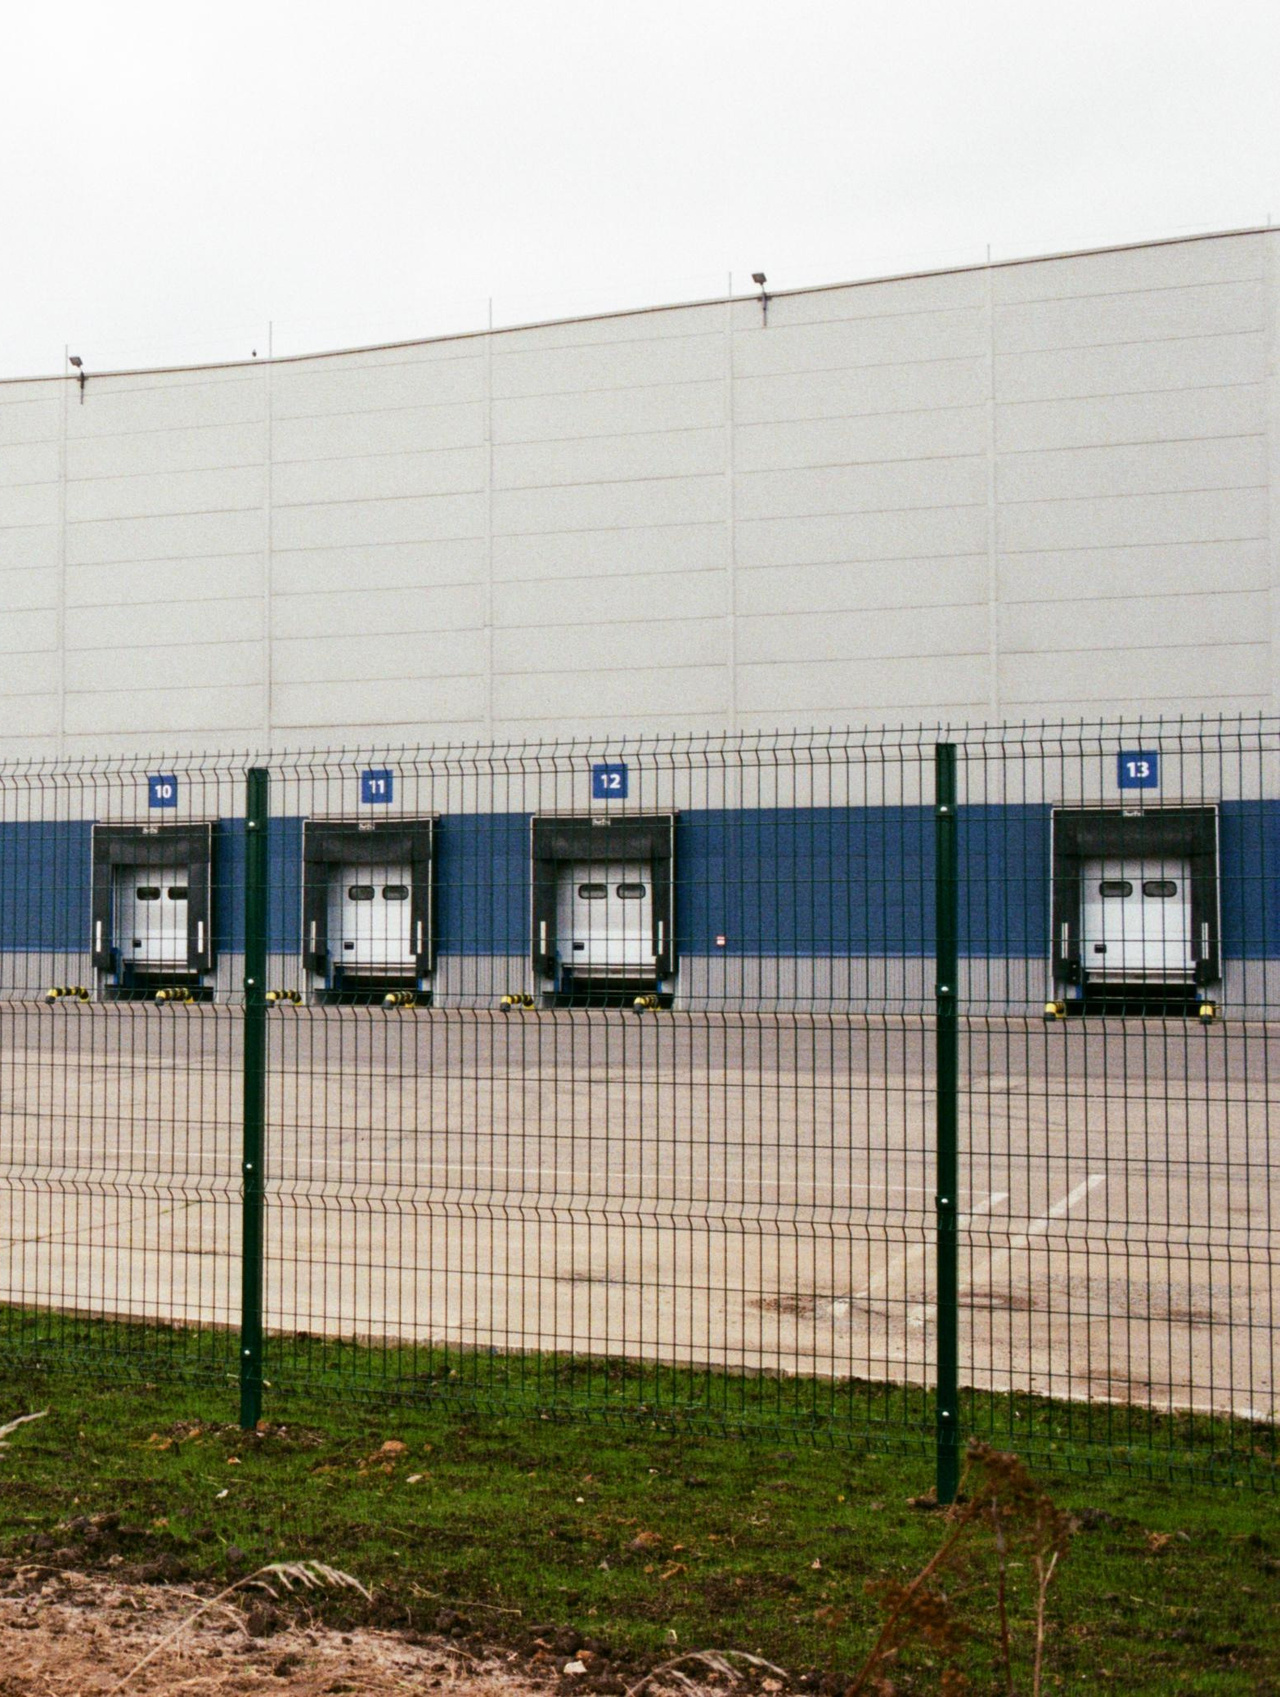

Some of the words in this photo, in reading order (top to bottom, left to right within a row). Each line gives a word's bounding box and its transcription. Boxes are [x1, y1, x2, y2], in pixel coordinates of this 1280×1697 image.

[1126, 761, 1150, 778] 13
[368, 779, 385, 794] 11
[600, 773, 621, 789] 12
[154, 784, 172, 799] 10
